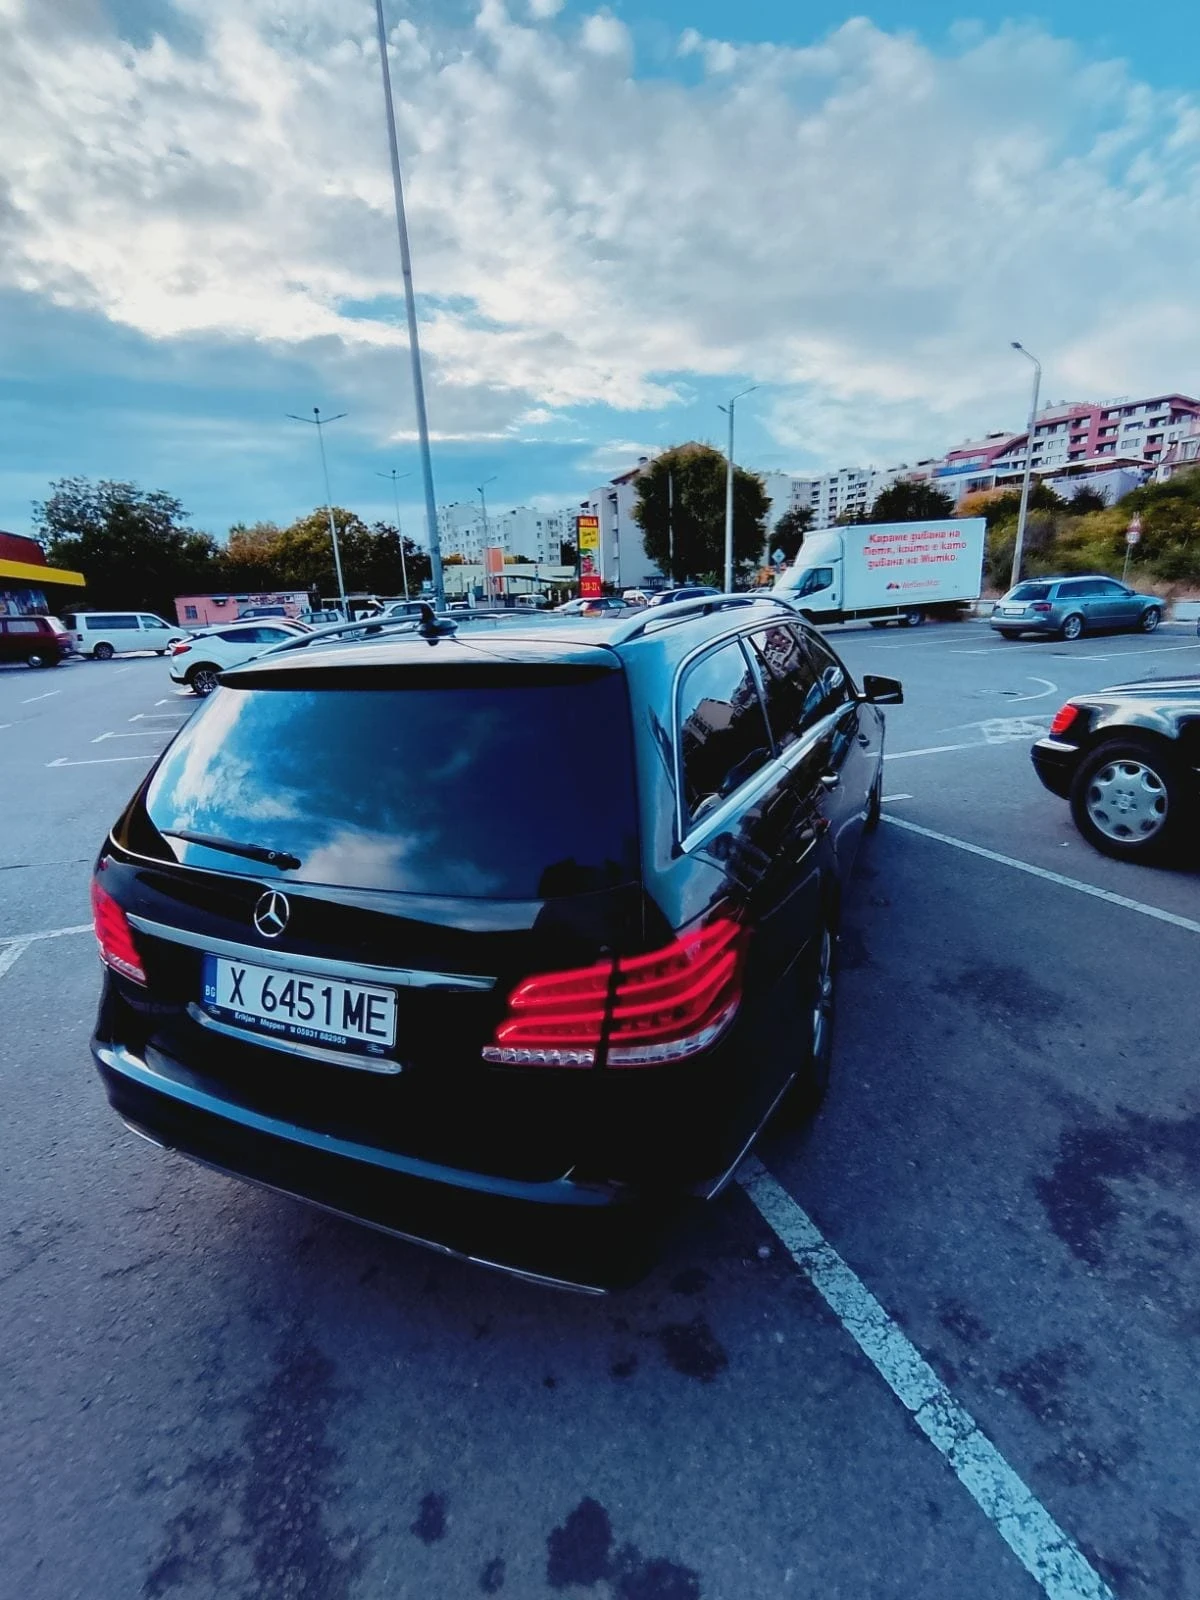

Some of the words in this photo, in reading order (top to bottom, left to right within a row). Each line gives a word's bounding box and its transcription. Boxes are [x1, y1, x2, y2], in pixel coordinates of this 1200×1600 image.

[869, 533, 908, 544] Караме
[941, 541, 967, 550] като
[204, 984, 216, 998] BG
[229, 967, 246, 1006] X
[260, 1018, 285, 1031] Meppen
